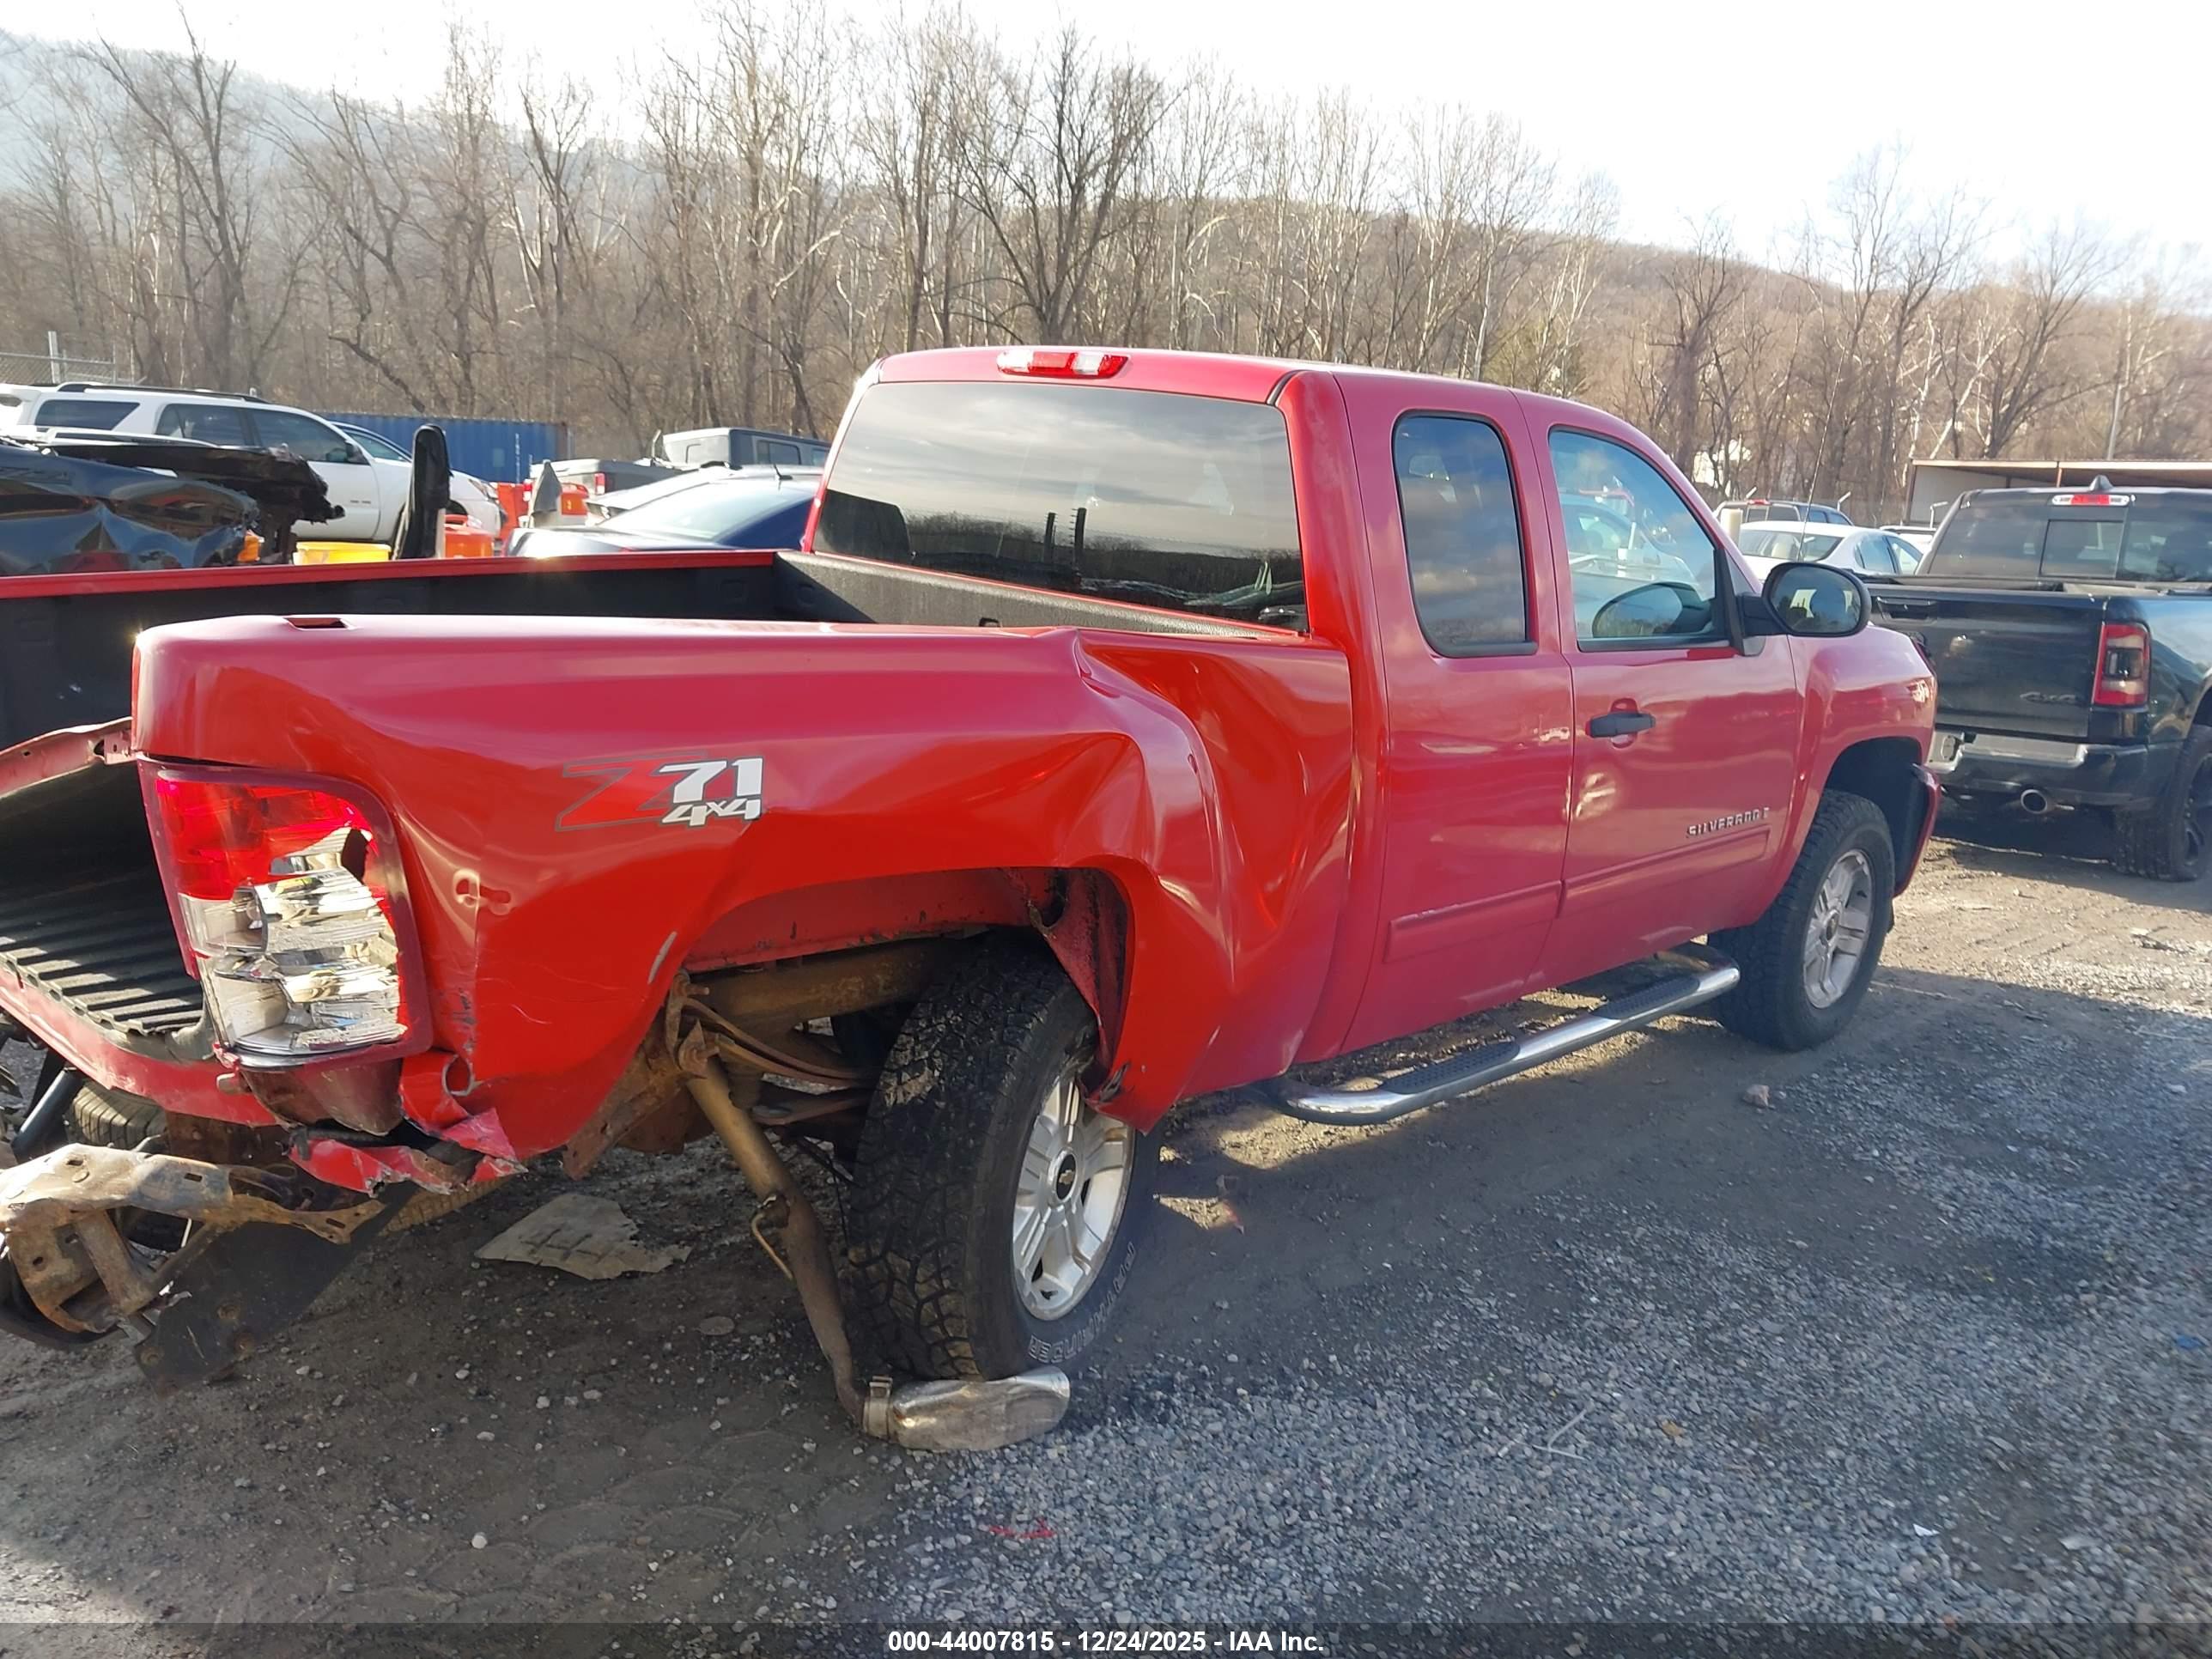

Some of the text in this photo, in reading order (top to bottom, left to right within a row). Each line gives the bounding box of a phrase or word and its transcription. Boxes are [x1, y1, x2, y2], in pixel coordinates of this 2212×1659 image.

[556, 752, 763, 831] Z71
[660, 797, 763, 827] 4x4
[1686, 807, 1760, 836] SILVERADO
